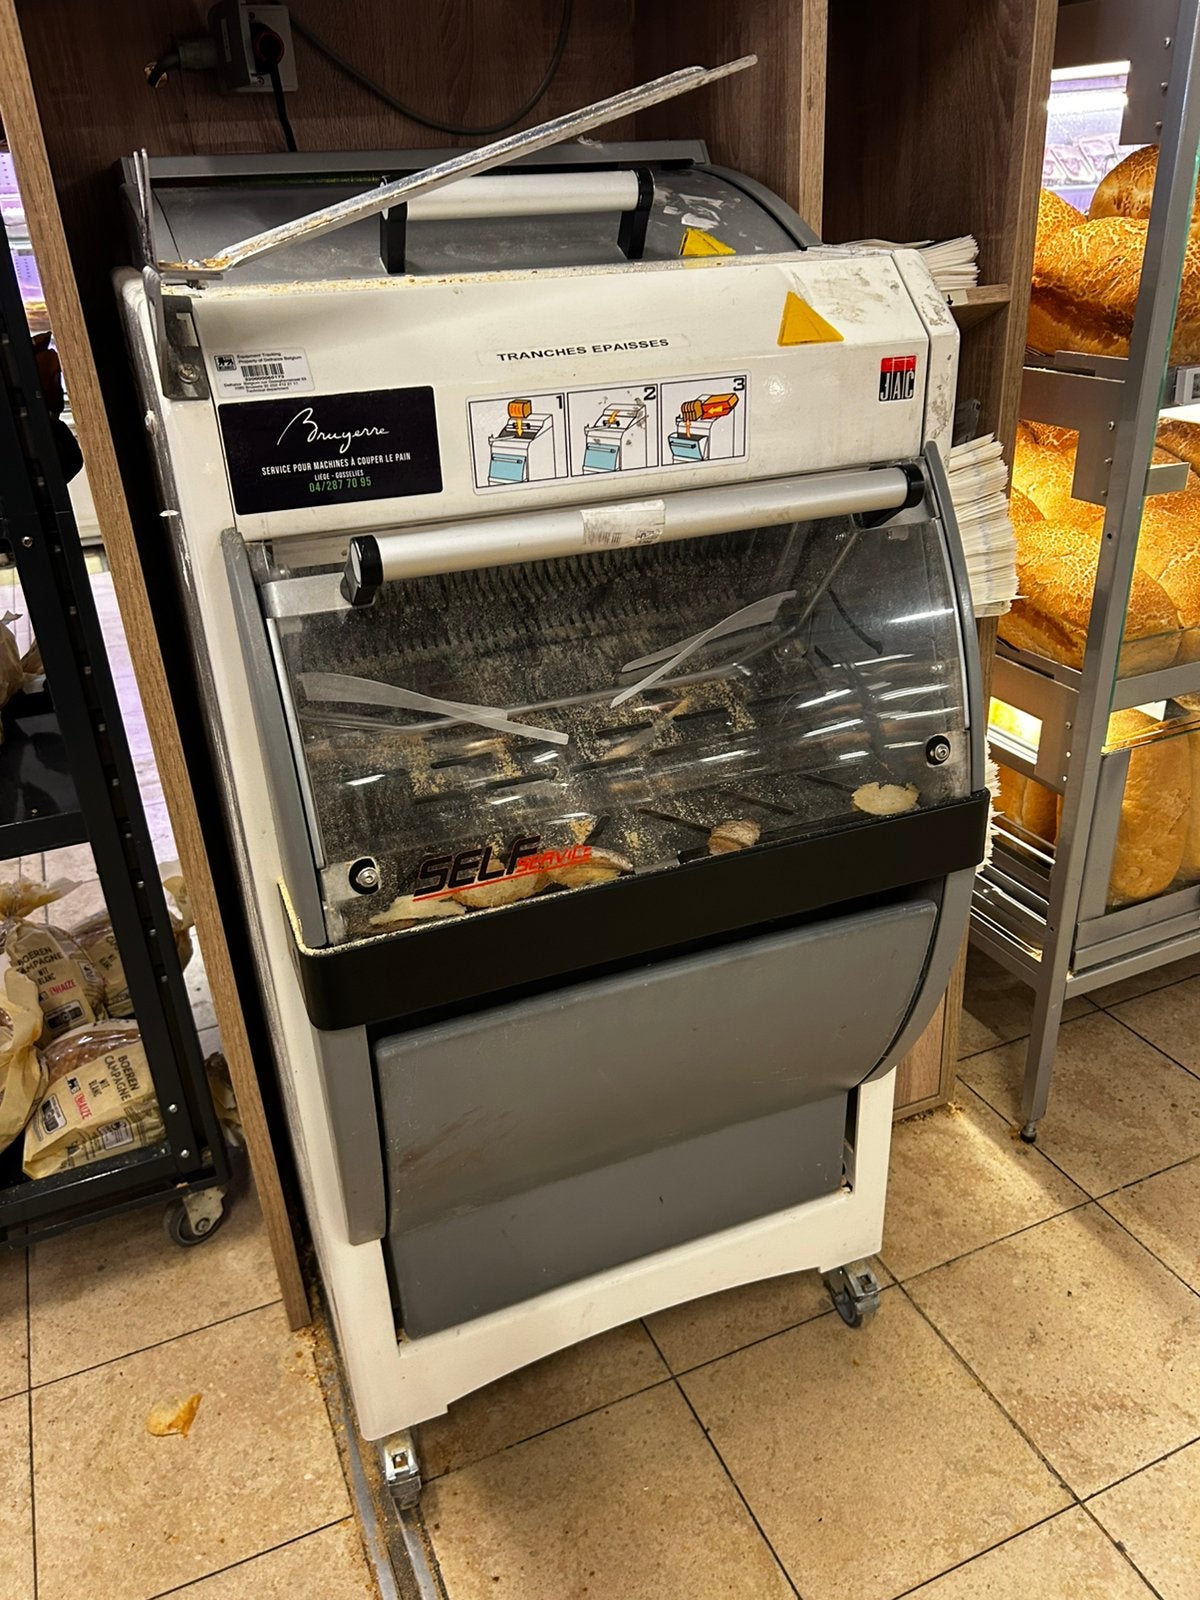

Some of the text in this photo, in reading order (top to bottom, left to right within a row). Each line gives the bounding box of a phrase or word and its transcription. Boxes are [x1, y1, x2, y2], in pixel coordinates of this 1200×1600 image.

[497, 338, 669, 361] TRANCHES EPAISSES
[644, 387, 656, 400] 2
[733, 378, 745, 391] 3
[880, 369, 915, 401] JAC
[556, 396, 563, 409] 1
[277, 407, 390, 454] Bruyerre
[262, 452, 411, 476] SERVICE POUR MACHINES À COUPER LE PAIN
[335, 469, 364, 479] GOSSELIES
[309, 476, 372, 492] 04/287 70 95
[412, 835, 593, 898] SELF SERVICE
[104, 1055, 132, 1101] CAMPAGNE
[118, 1055, 139, 1091] BOEREN
